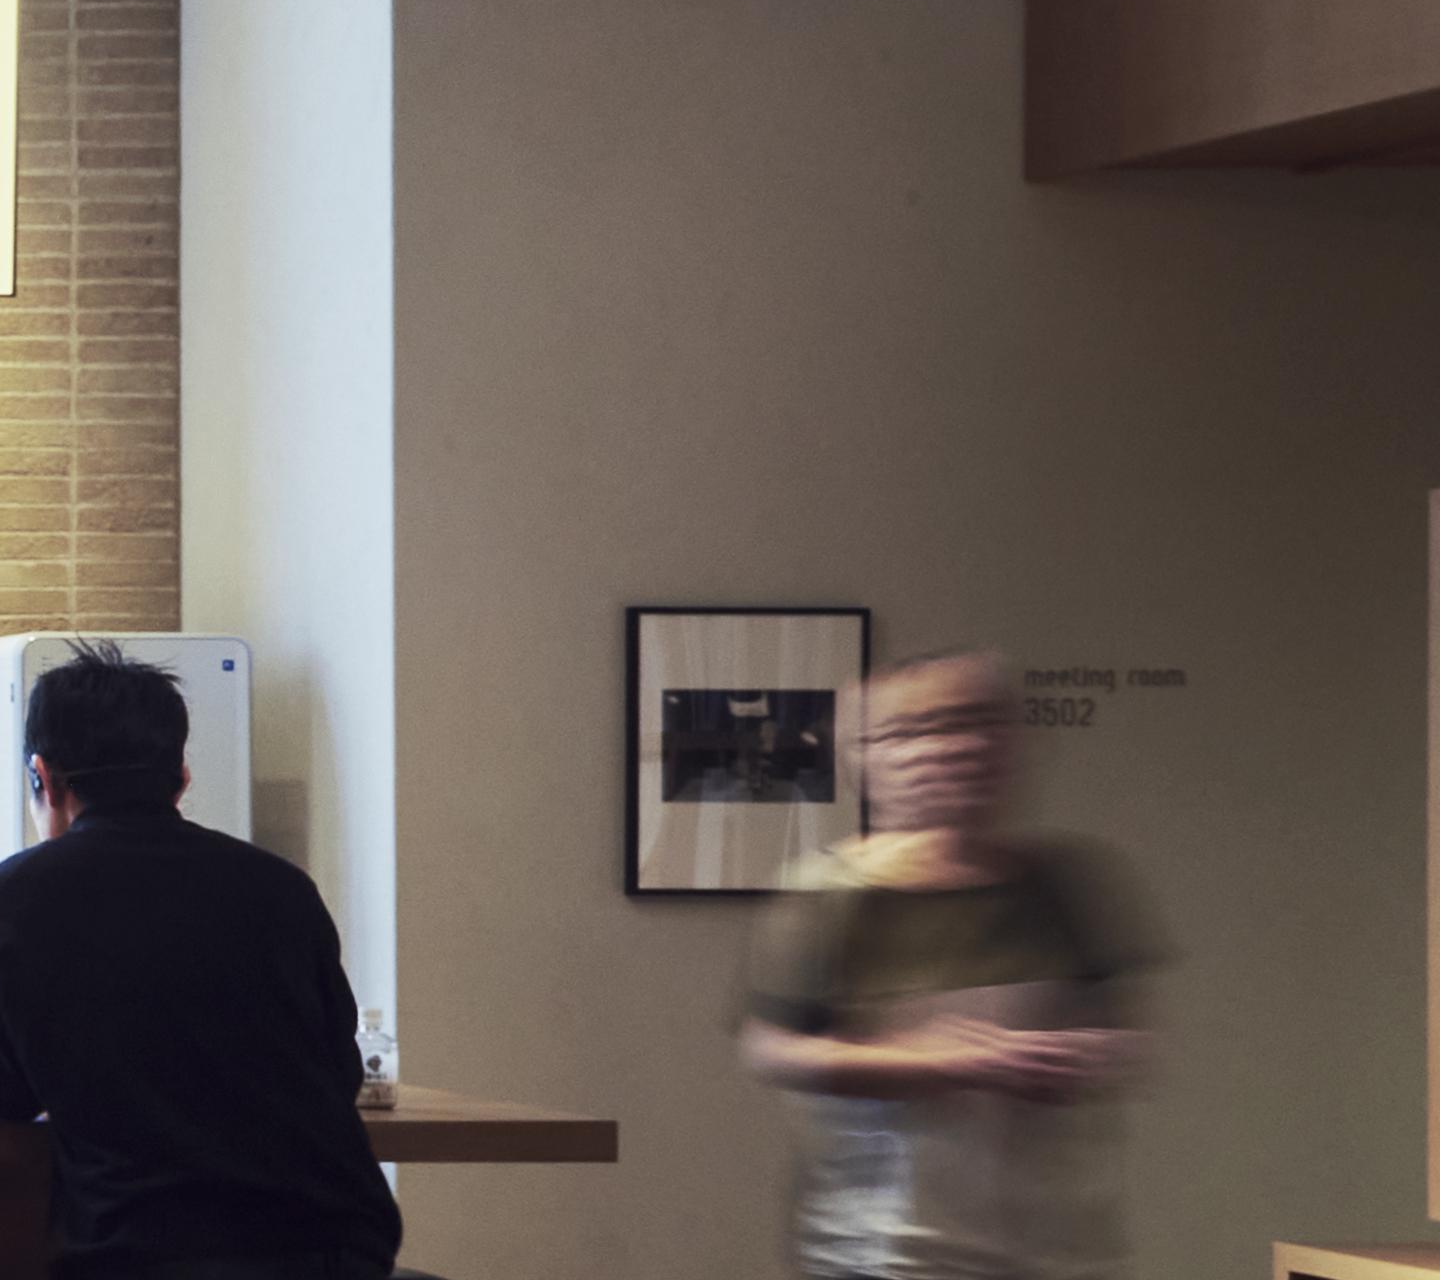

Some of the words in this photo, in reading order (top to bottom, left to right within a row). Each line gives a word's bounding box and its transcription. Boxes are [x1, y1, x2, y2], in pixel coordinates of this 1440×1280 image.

[1023, 666, 1116, 694] meeting
[1127, 669, 1186, 687] room
[1023, 696, 1096, 727] 3502
